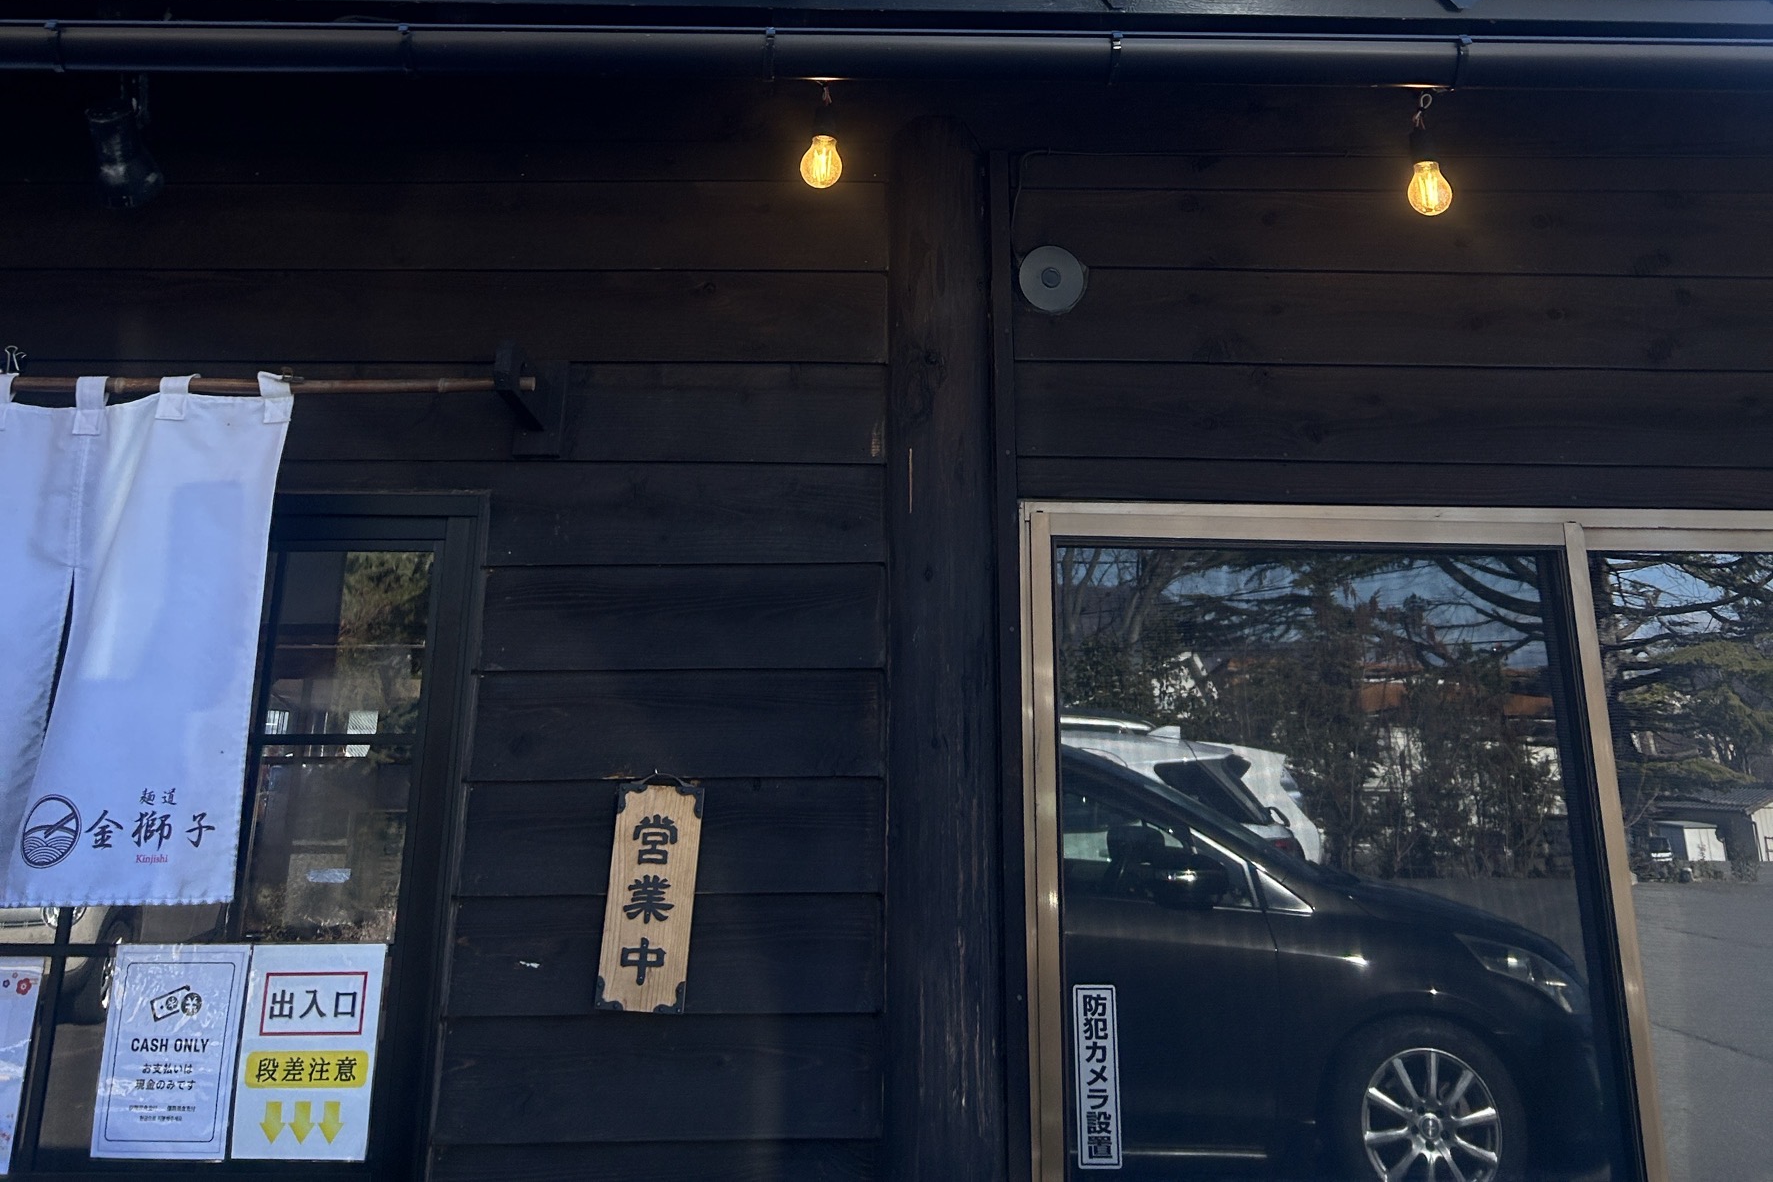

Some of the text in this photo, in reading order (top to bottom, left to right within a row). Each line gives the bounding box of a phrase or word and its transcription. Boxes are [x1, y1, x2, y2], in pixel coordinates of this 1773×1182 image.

[84, 809, 216, 851] 金獅子
[135, 854, 169, 864] Kinjishi
[620, 814, 678, 985] 営業中
[268, 989, 358, 1020] 出入口
[131, 1038, 209, 1053] CASH ONLY
[142, 1063, 193, 1074] お支払いは
[255, 1057, 358, 1083] 段差注意
[1082, 994, 1113, 1160] 防犯カメラ設置
[135, 1079, 196, 1091] 現金のみです
